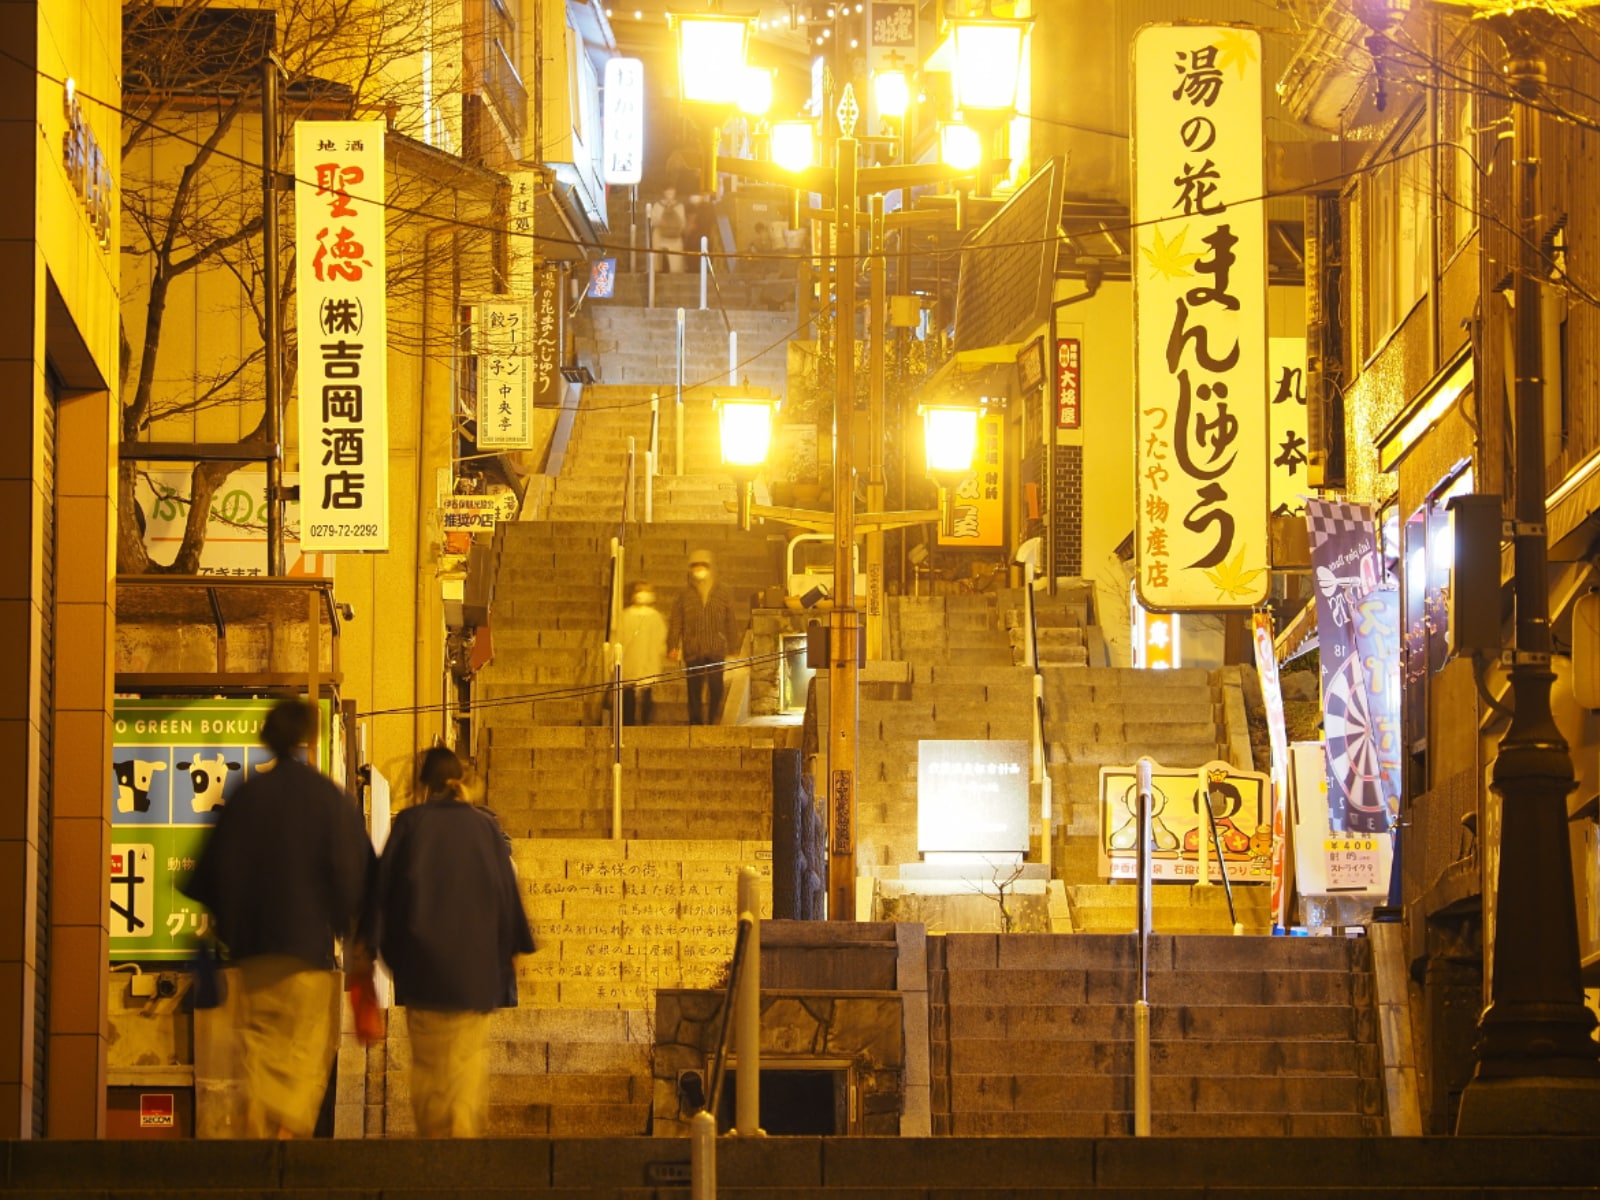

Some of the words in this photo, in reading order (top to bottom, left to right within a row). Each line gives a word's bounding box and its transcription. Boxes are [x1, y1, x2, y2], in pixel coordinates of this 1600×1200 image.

[317, 139, 364, 152] 地酒
[313, 162, 374, 283] 聖徳
[1166, 45, 1240, 570] 湯の花まんじゅう
[490, 311, 505, 376] 餃子
[507, 312, 520, 376] ラーメン
[498, 384, 512, 431] 中央亭
[1143, 406, 1170, 588] つたや物産店
[310, 524, 378, 537] 0279-72-2292
[135, 720, 192, 734] GREEN
[1111, 864, 1162, 874] 伊香泉
[143, 1116, 171, 1124] SECOM
